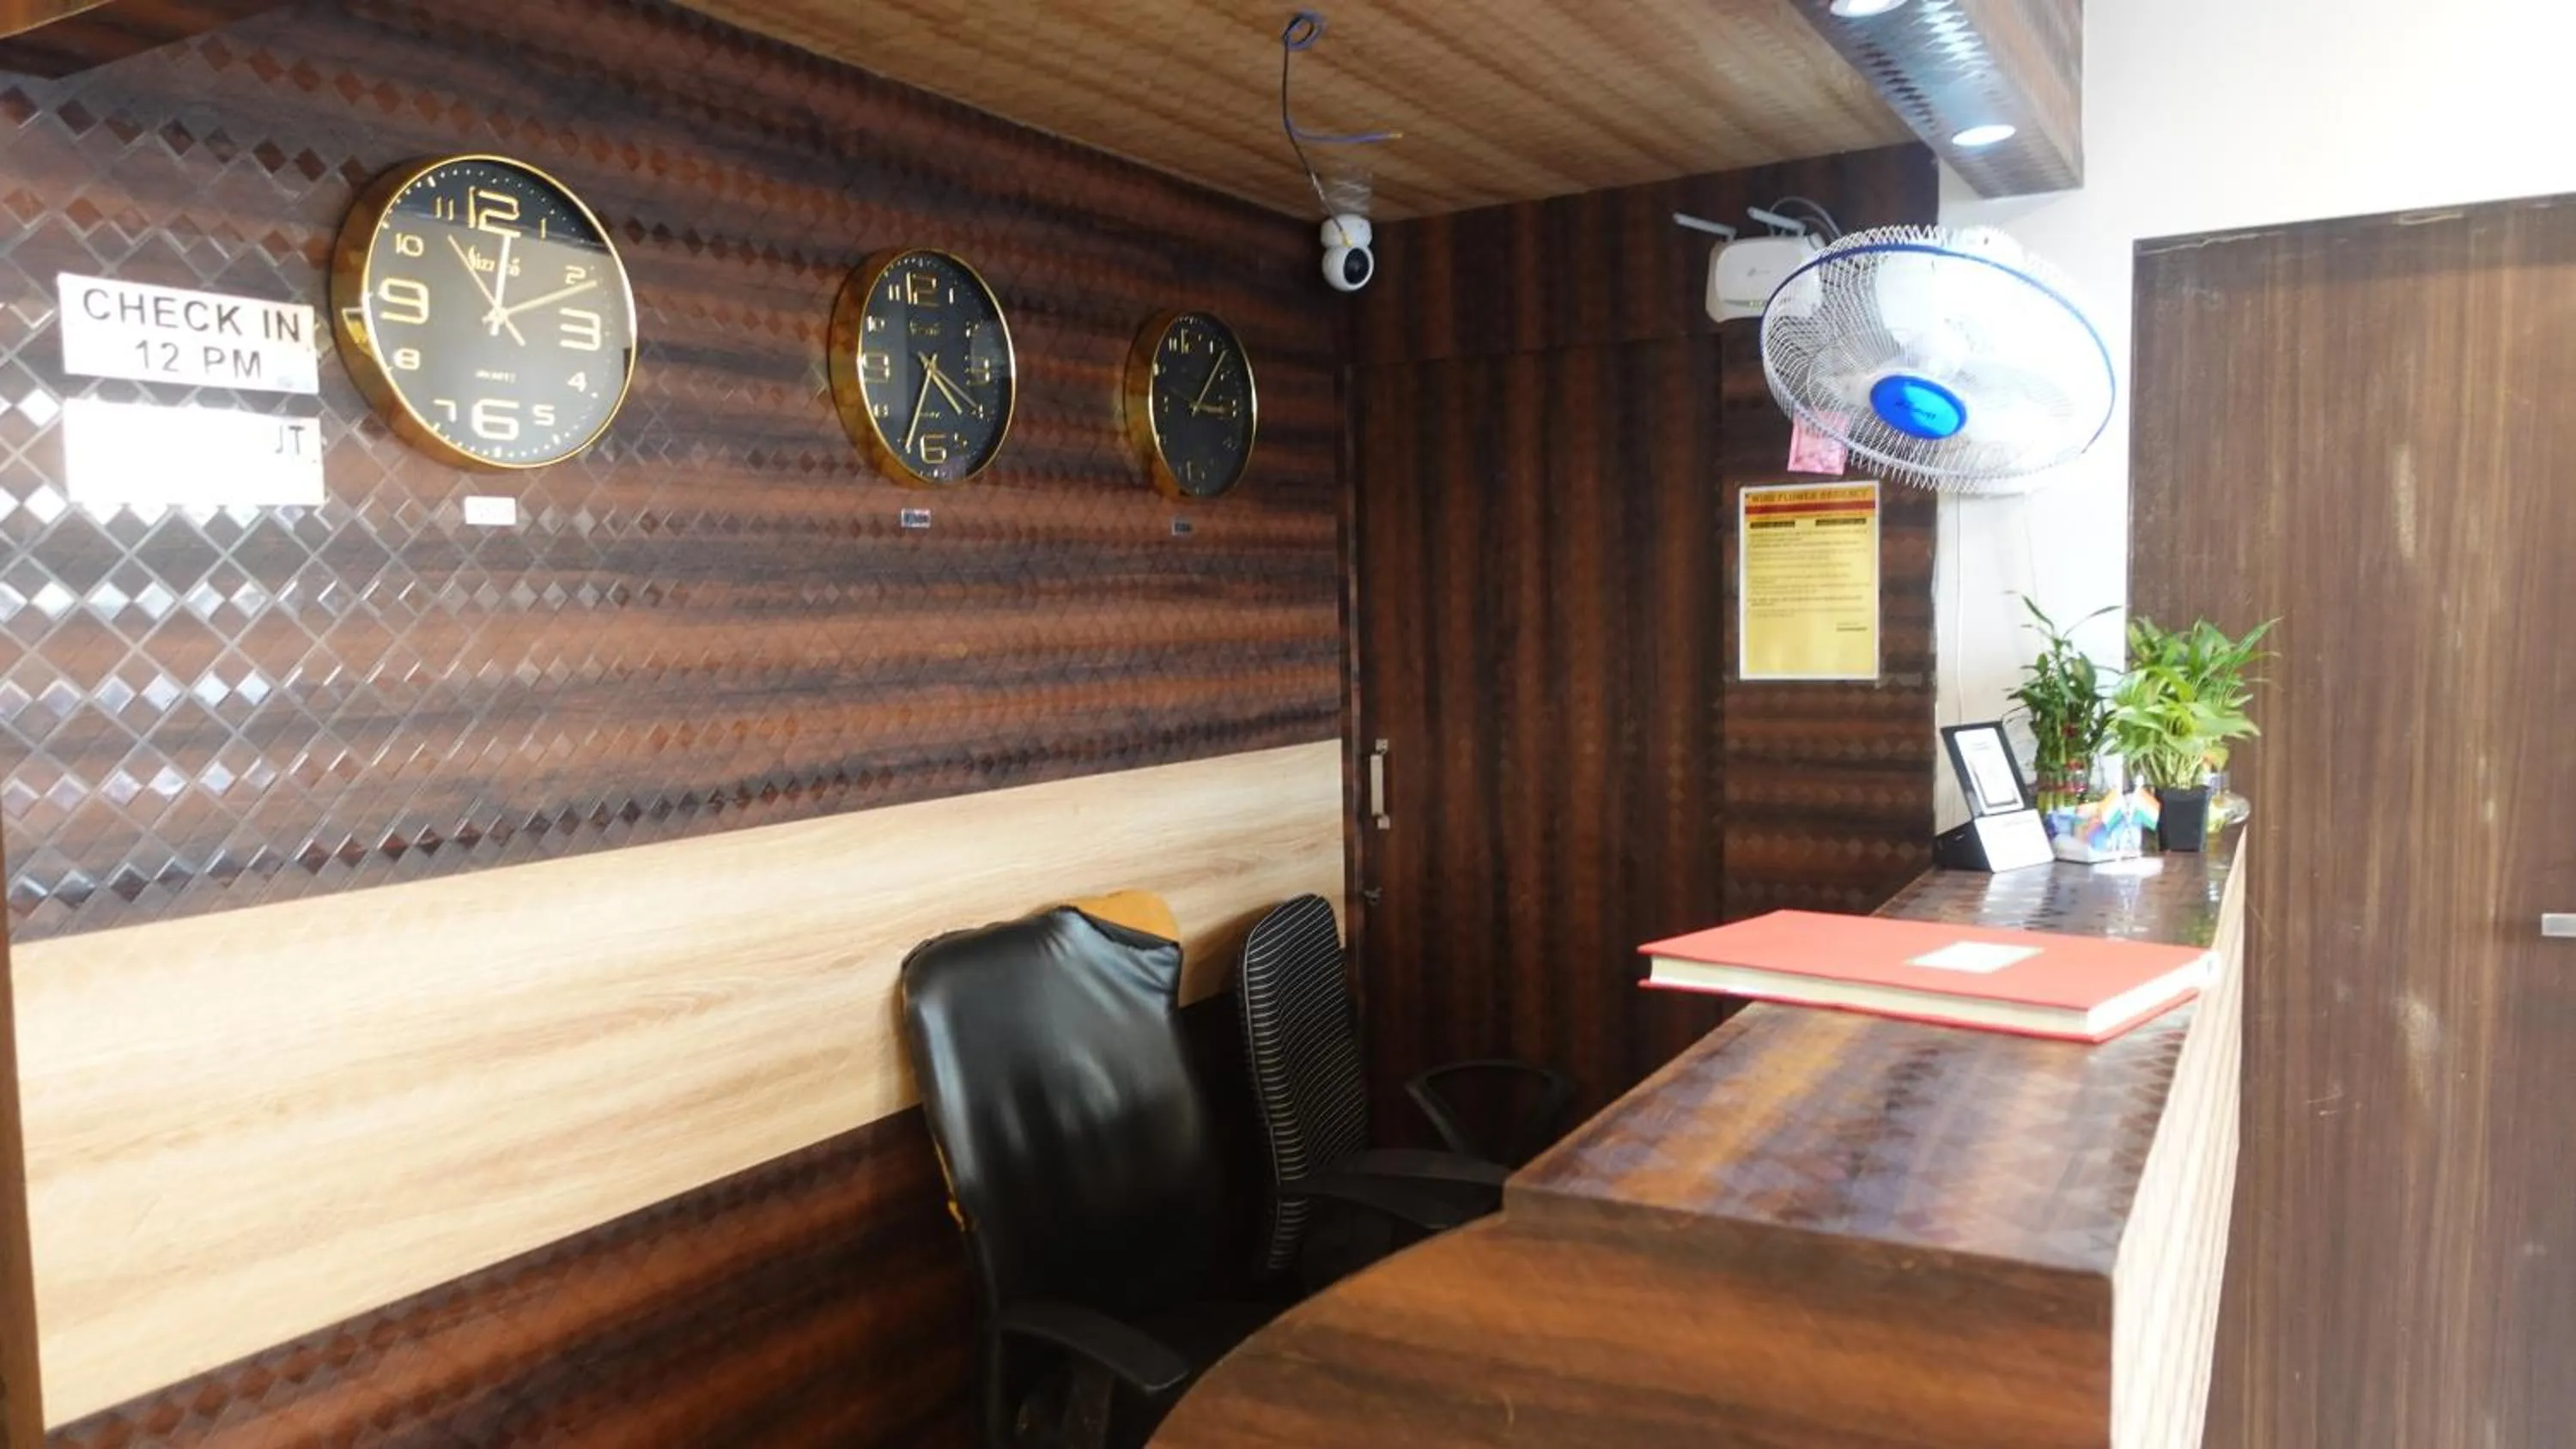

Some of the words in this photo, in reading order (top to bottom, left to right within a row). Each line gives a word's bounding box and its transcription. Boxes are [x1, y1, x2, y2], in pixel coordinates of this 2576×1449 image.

[435, 196, 454, 221] 11
[467, 185, 521, 239] 12
[540, 217, 547, 239] 1
[395, 232, 425, 258] 10
[564, 264, 587, 285] 2
[378, 276, 429, 325] 9
[888, 283, 902, 301] 11
[906, 271, 940, 308] 12
[82, 288, 243, 336] CHECK
[263, 309, 301, 343] IN
[558, 306, 602, 352] 3
[135, 339, 179, 373] 12
[203, 345, 262, 379] PM
[392, 347, 421, 371] 8
[567, 371, 589, 392] 4
[433, 398, 458, 423] 7
[471, 397, 521, 441] 6
[532, 403, 556, 427] 5
[920, 432, 948, 465] 6
